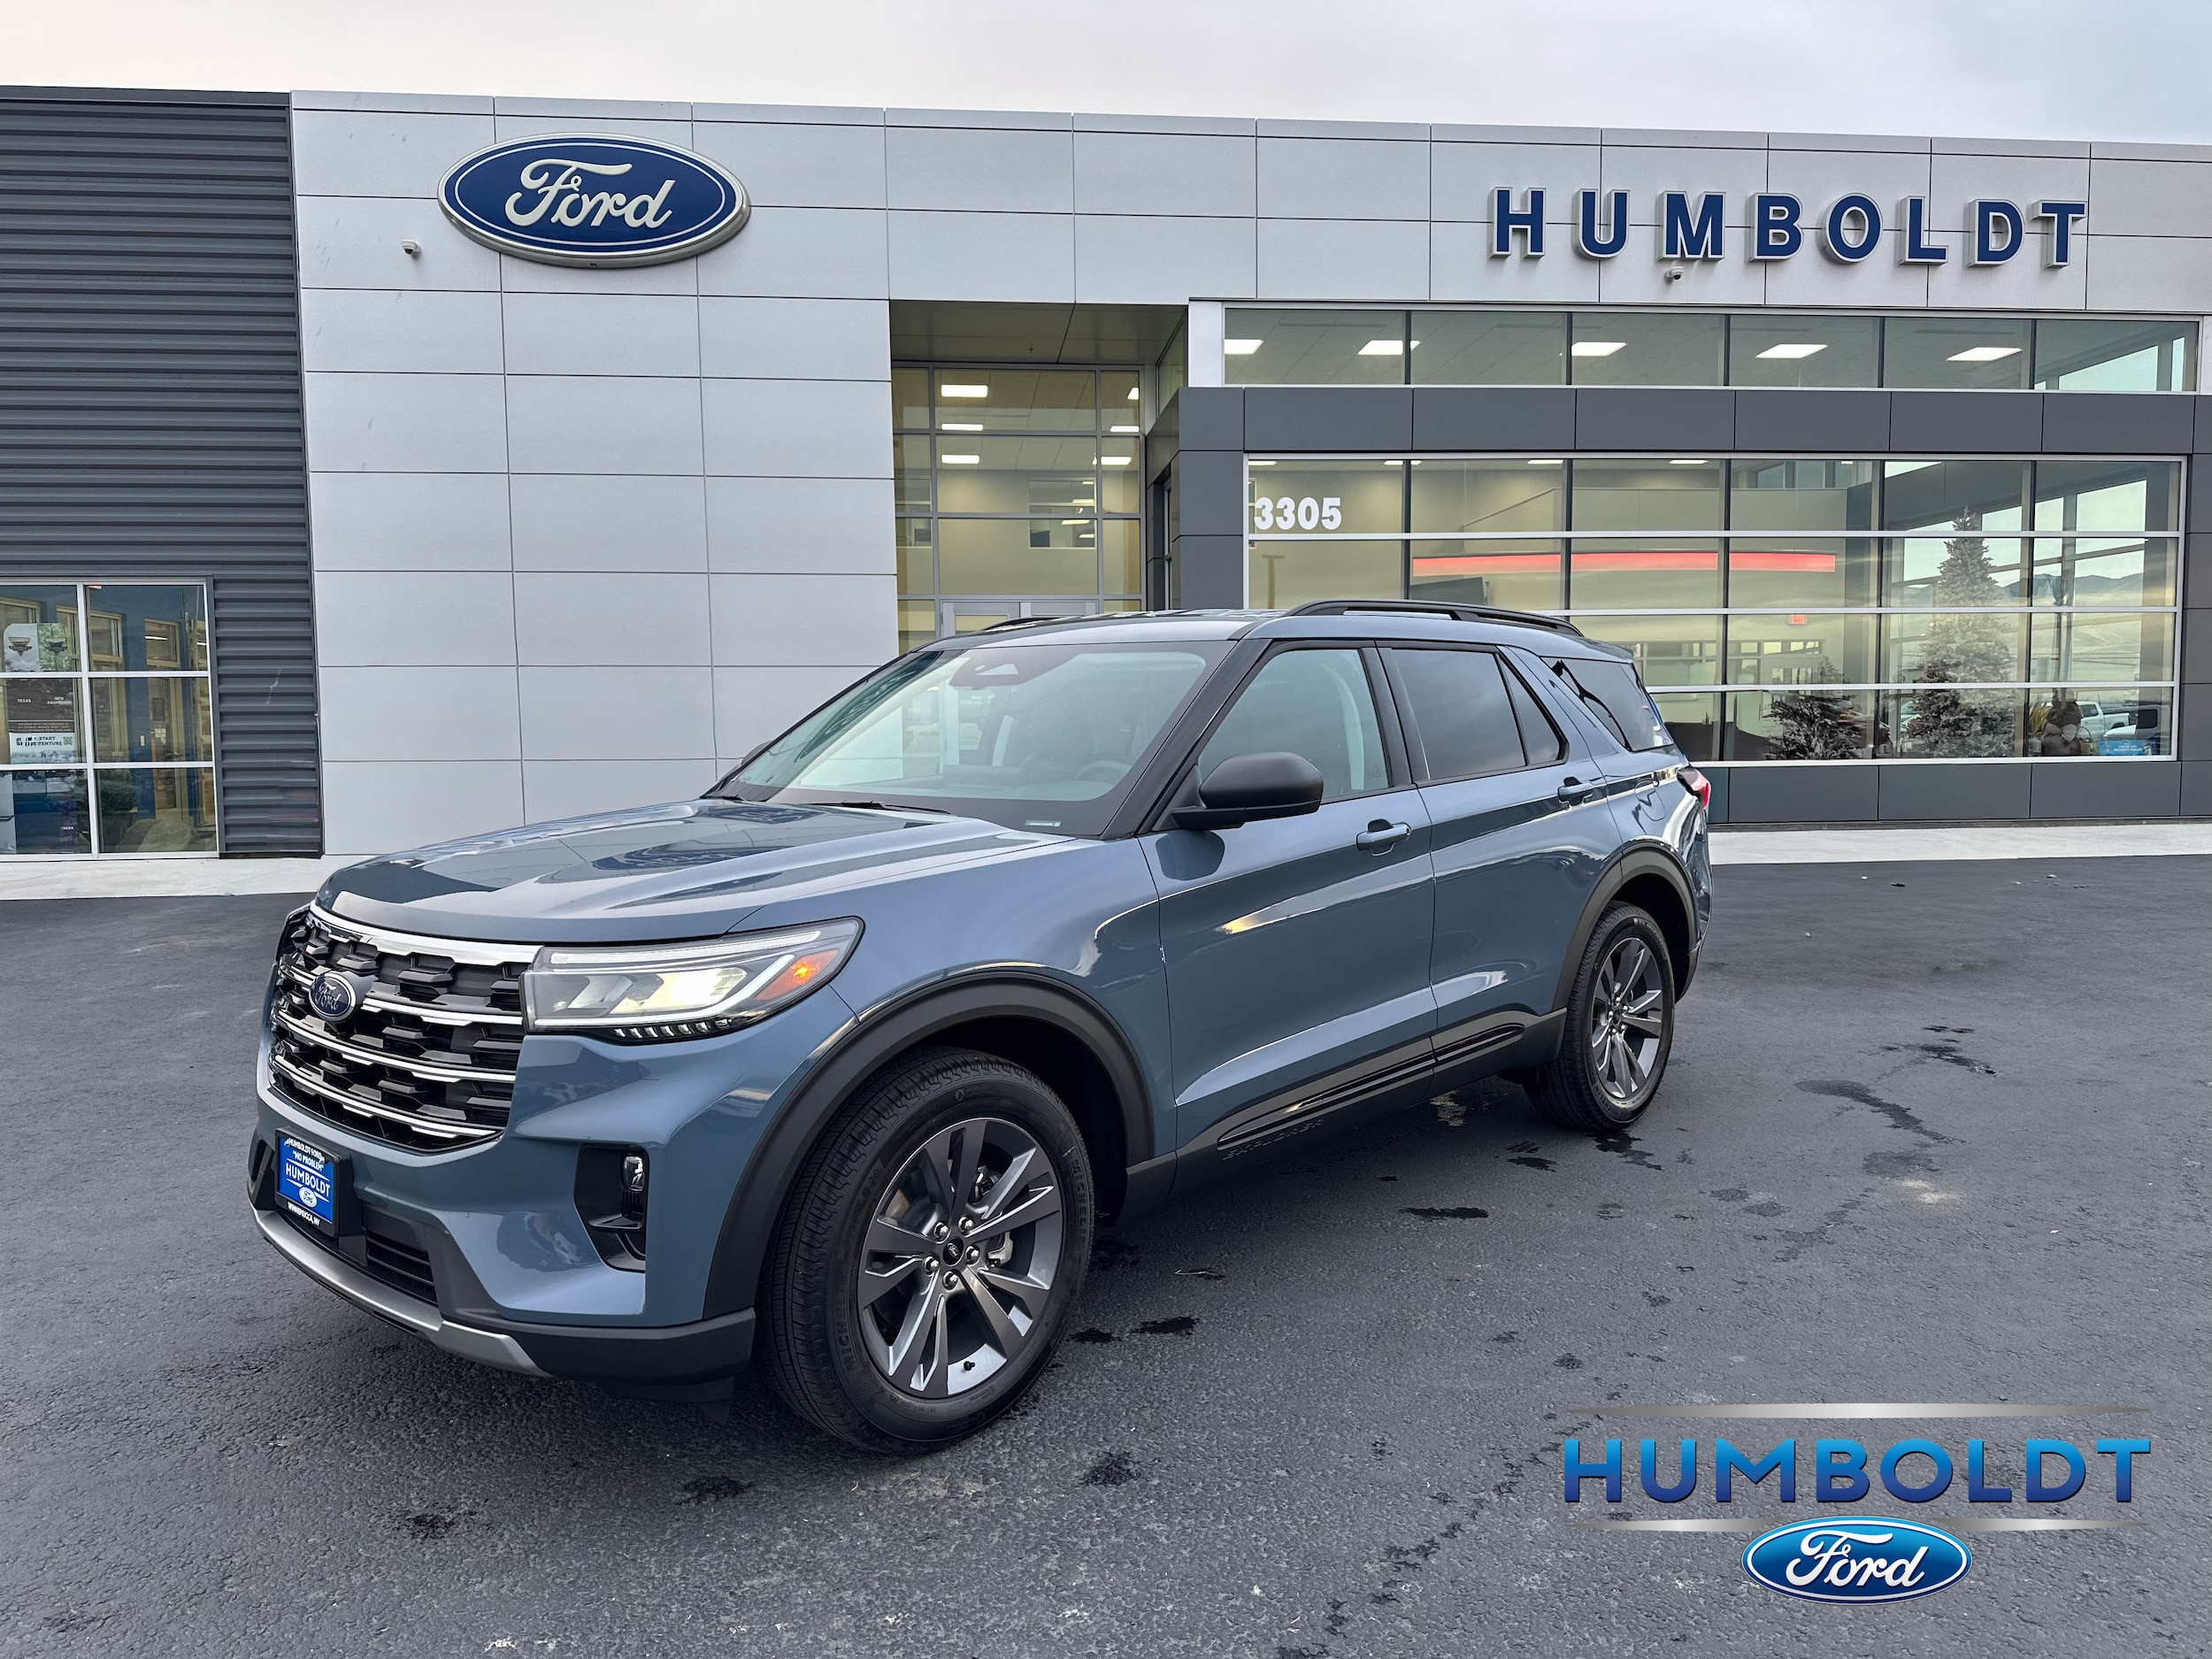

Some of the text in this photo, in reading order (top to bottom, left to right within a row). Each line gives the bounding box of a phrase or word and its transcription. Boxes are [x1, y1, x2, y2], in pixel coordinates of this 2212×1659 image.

[505, 158, 676, 228] Ford
[1489, 186, 2088, 268] HUMBOLDT
[1254, 496, 1342, 530] 3305
[315, 981, 342, 1010] Ford
[288, 1138, 311, 1155] HUMBOLDT
[1222, 1118, 1324, 1161] EXPLORER
[285, 1163, 330, 1197] HUMBOLDT
